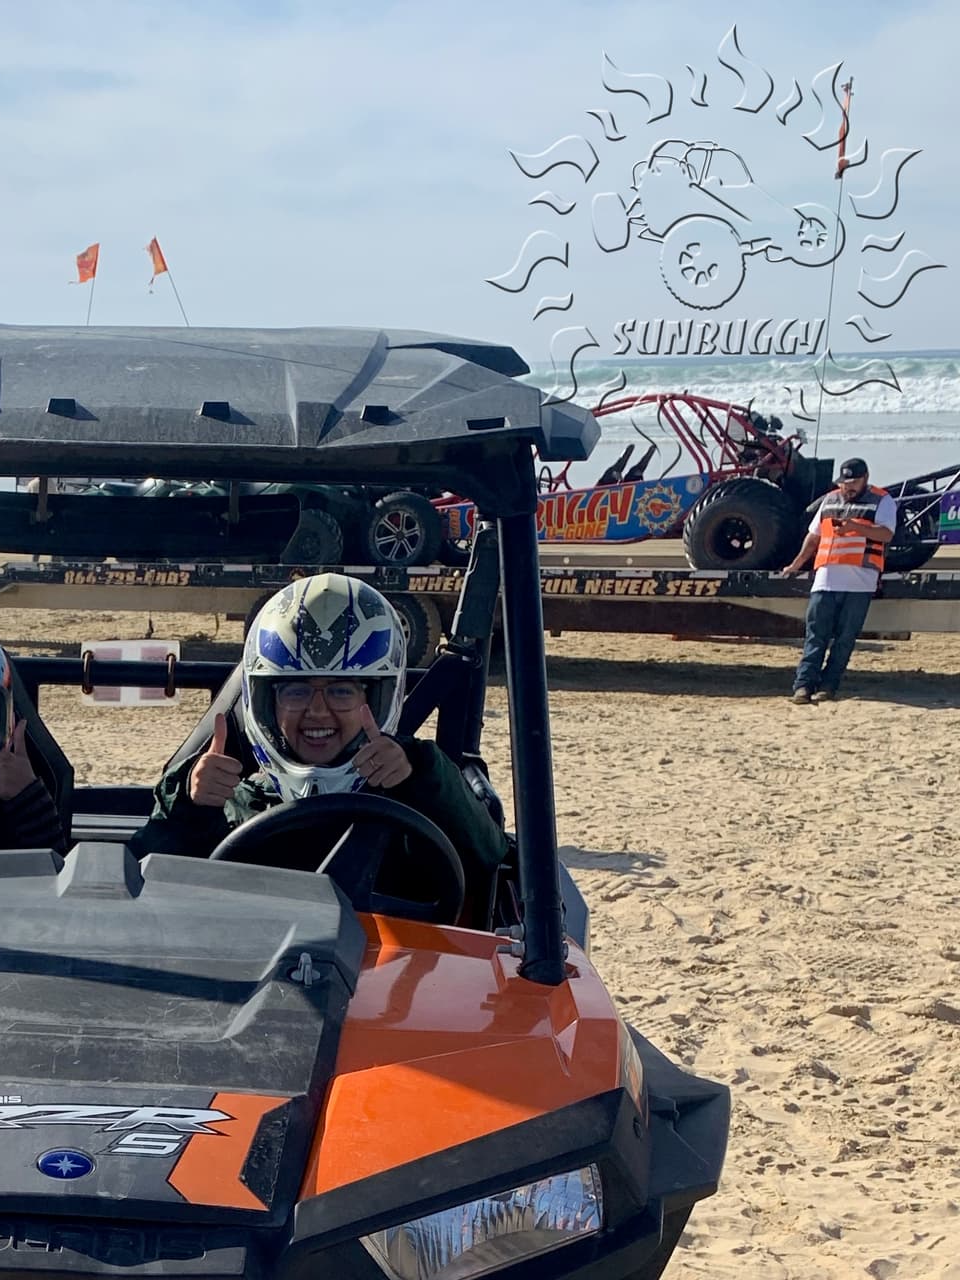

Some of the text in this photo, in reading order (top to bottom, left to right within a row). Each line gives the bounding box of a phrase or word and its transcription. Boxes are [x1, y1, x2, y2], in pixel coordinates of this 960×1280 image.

[584, 579, 658, 595] NEVER
[665, 580, 722, 596] SETS
[108, 1131, 184, 1157] S
